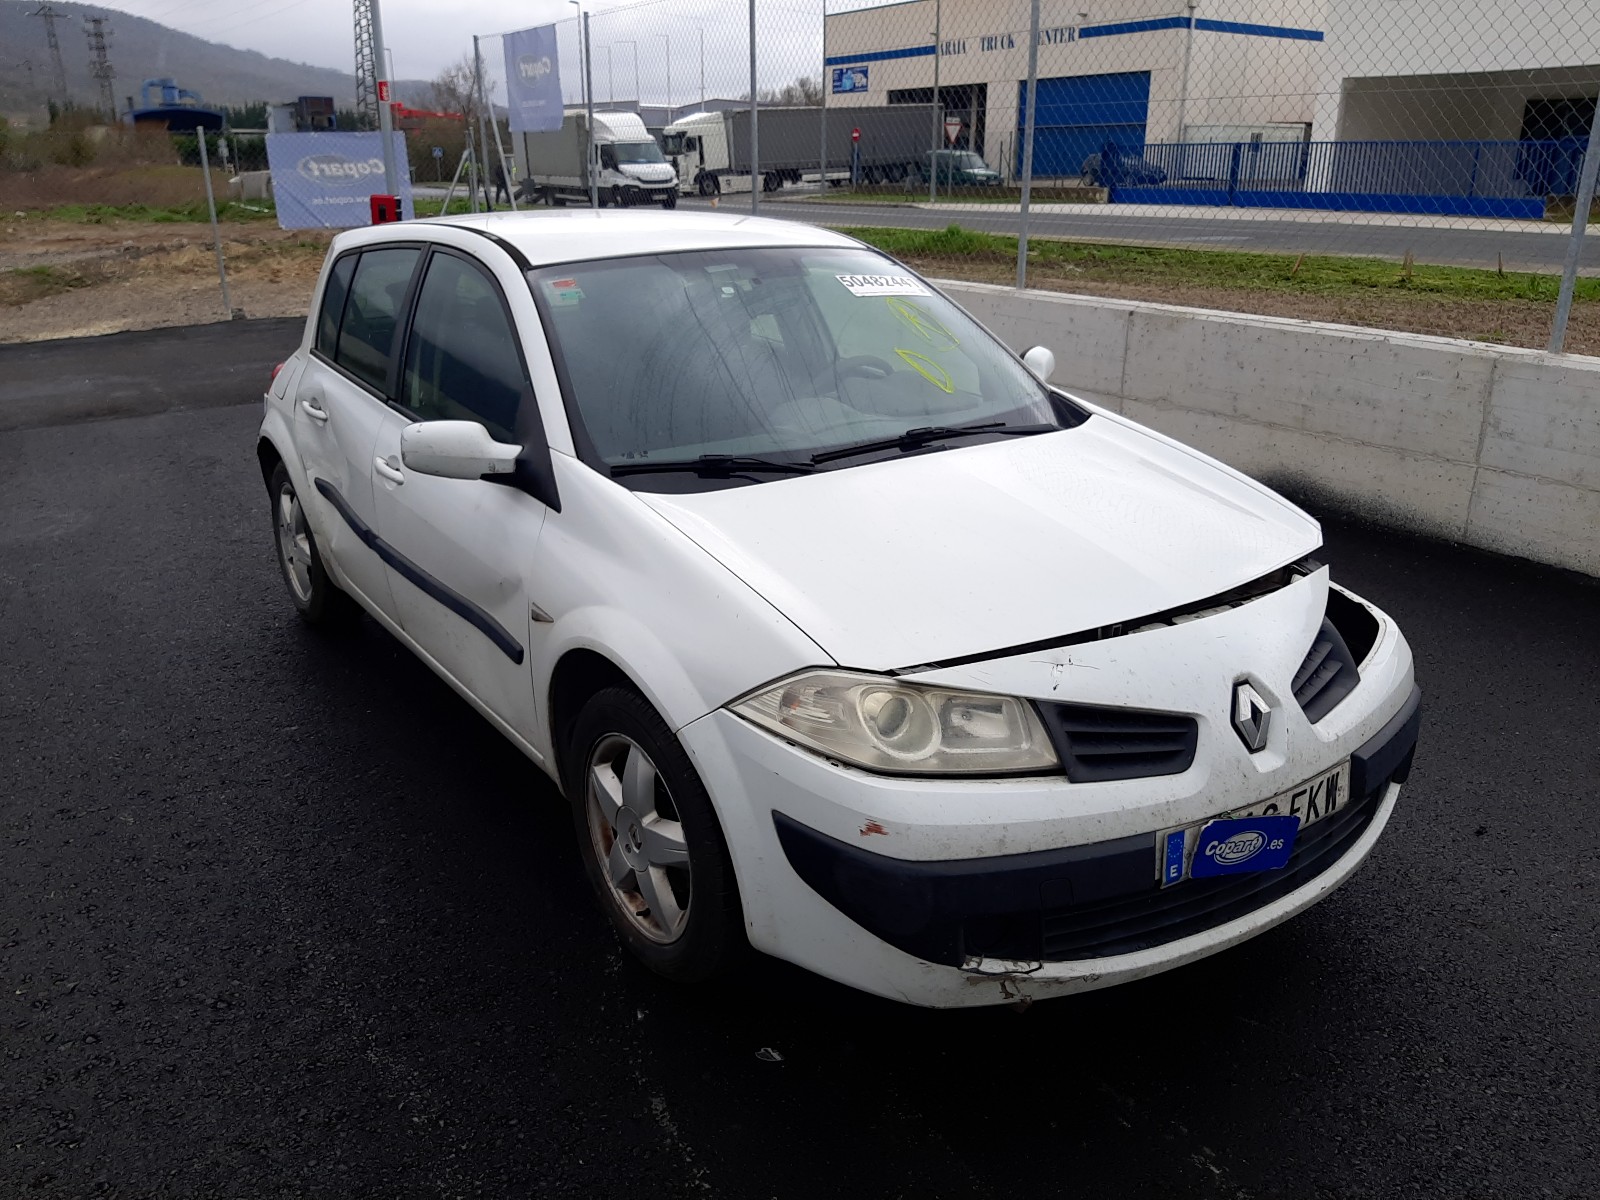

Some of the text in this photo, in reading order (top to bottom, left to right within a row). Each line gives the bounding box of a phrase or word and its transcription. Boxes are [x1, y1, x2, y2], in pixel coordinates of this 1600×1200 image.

[981, 33, 1015, 52] TRUCK
[1037, 27, 1076, 46] ENTER
[1169, 864, 1179, 878] E
